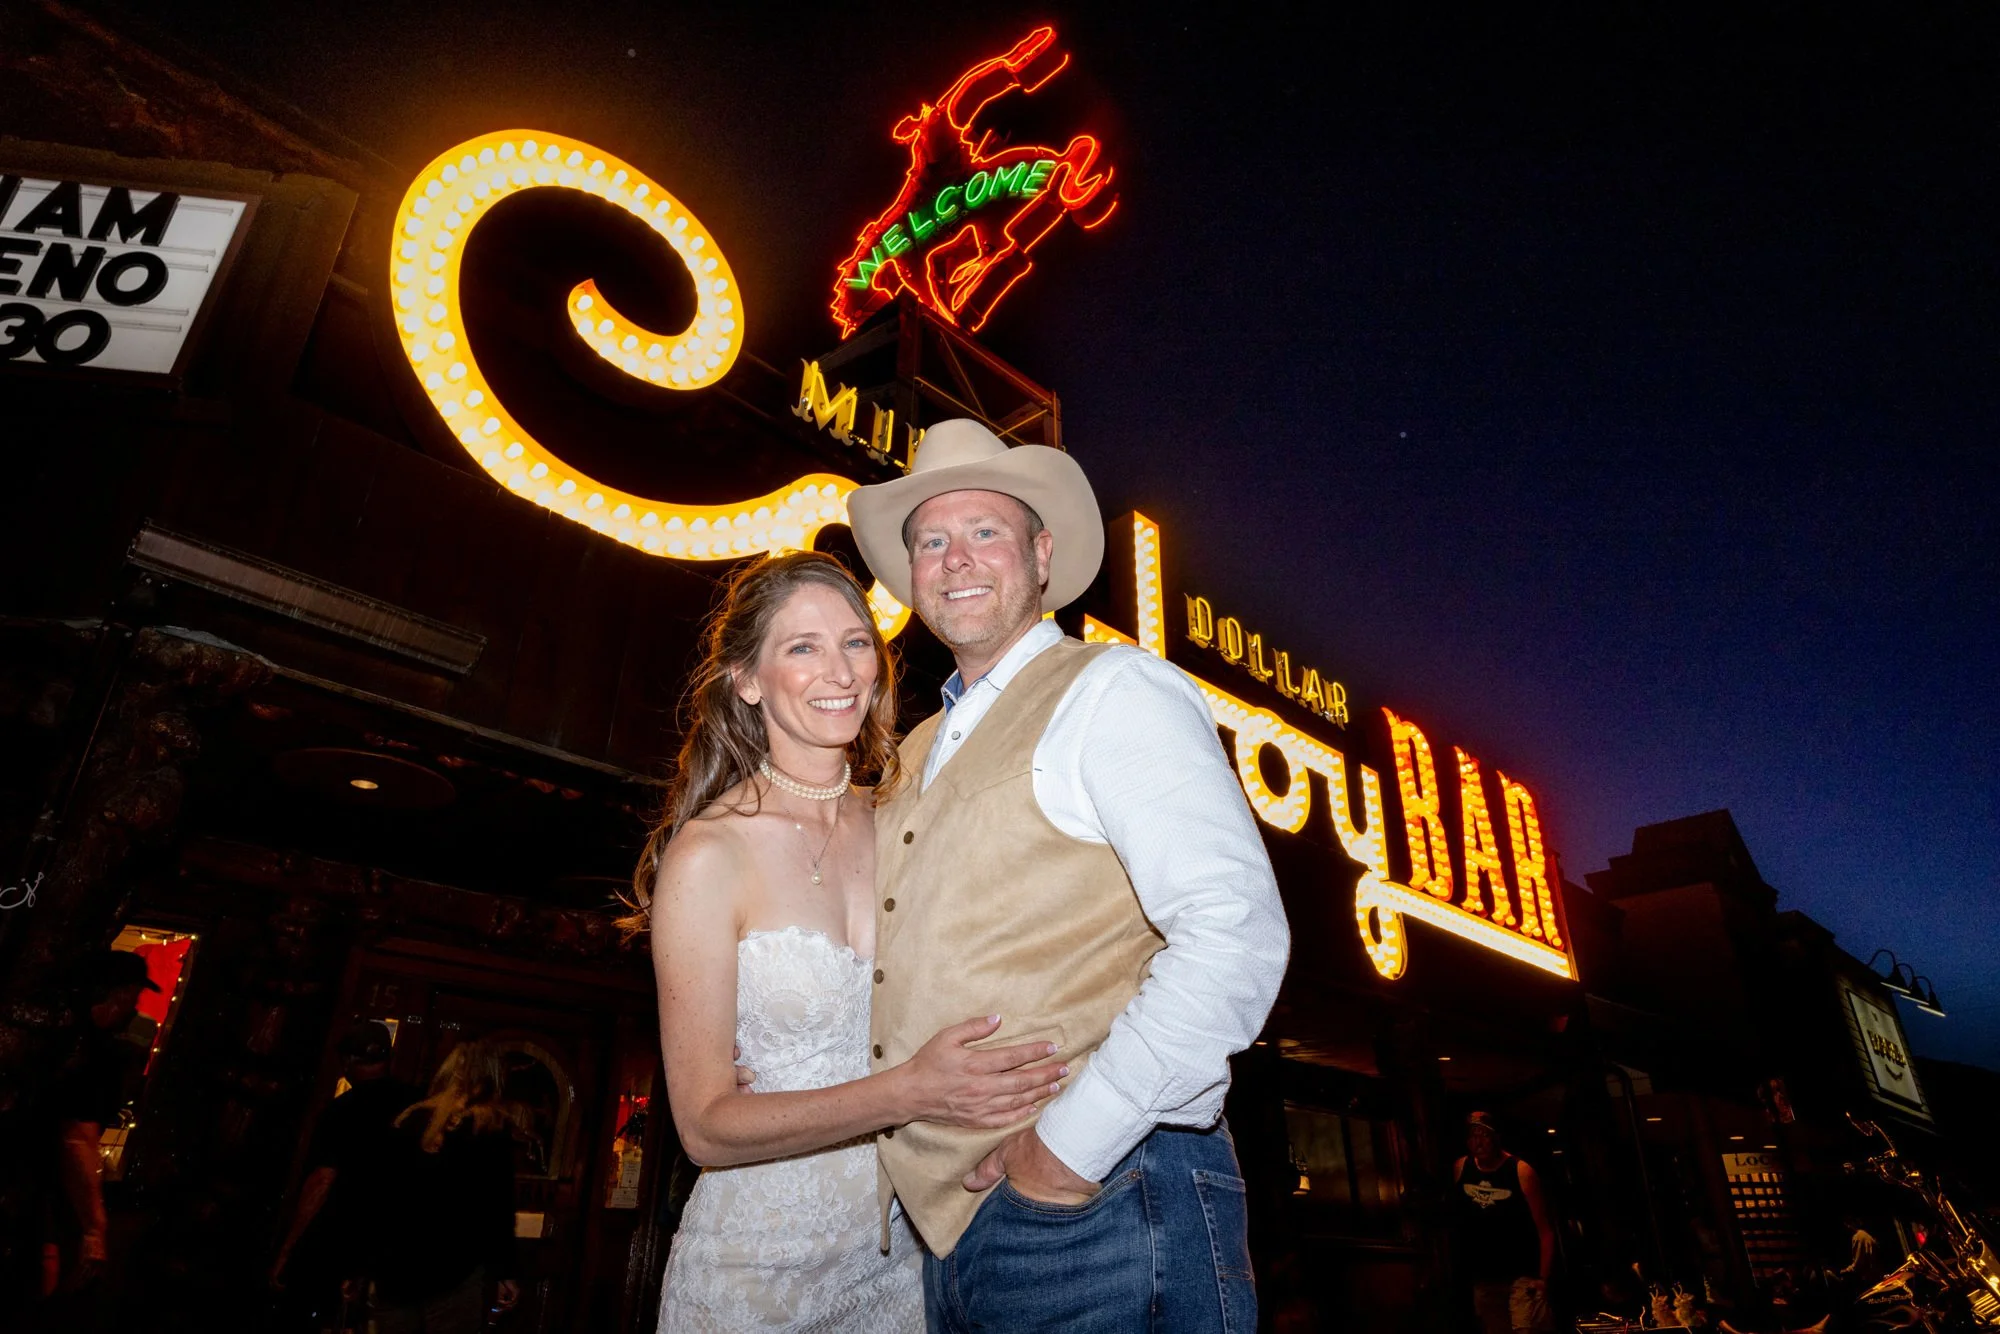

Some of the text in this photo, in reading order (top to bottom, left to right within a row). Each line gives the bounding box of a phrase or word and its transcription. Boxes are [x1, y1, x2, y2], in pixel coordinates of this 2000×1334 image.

[843, 160, 1055, 290] WELCOME
[1184, 593, 1350, 730] DOLLAR
[1381, 706, 1566, 951] BAR
